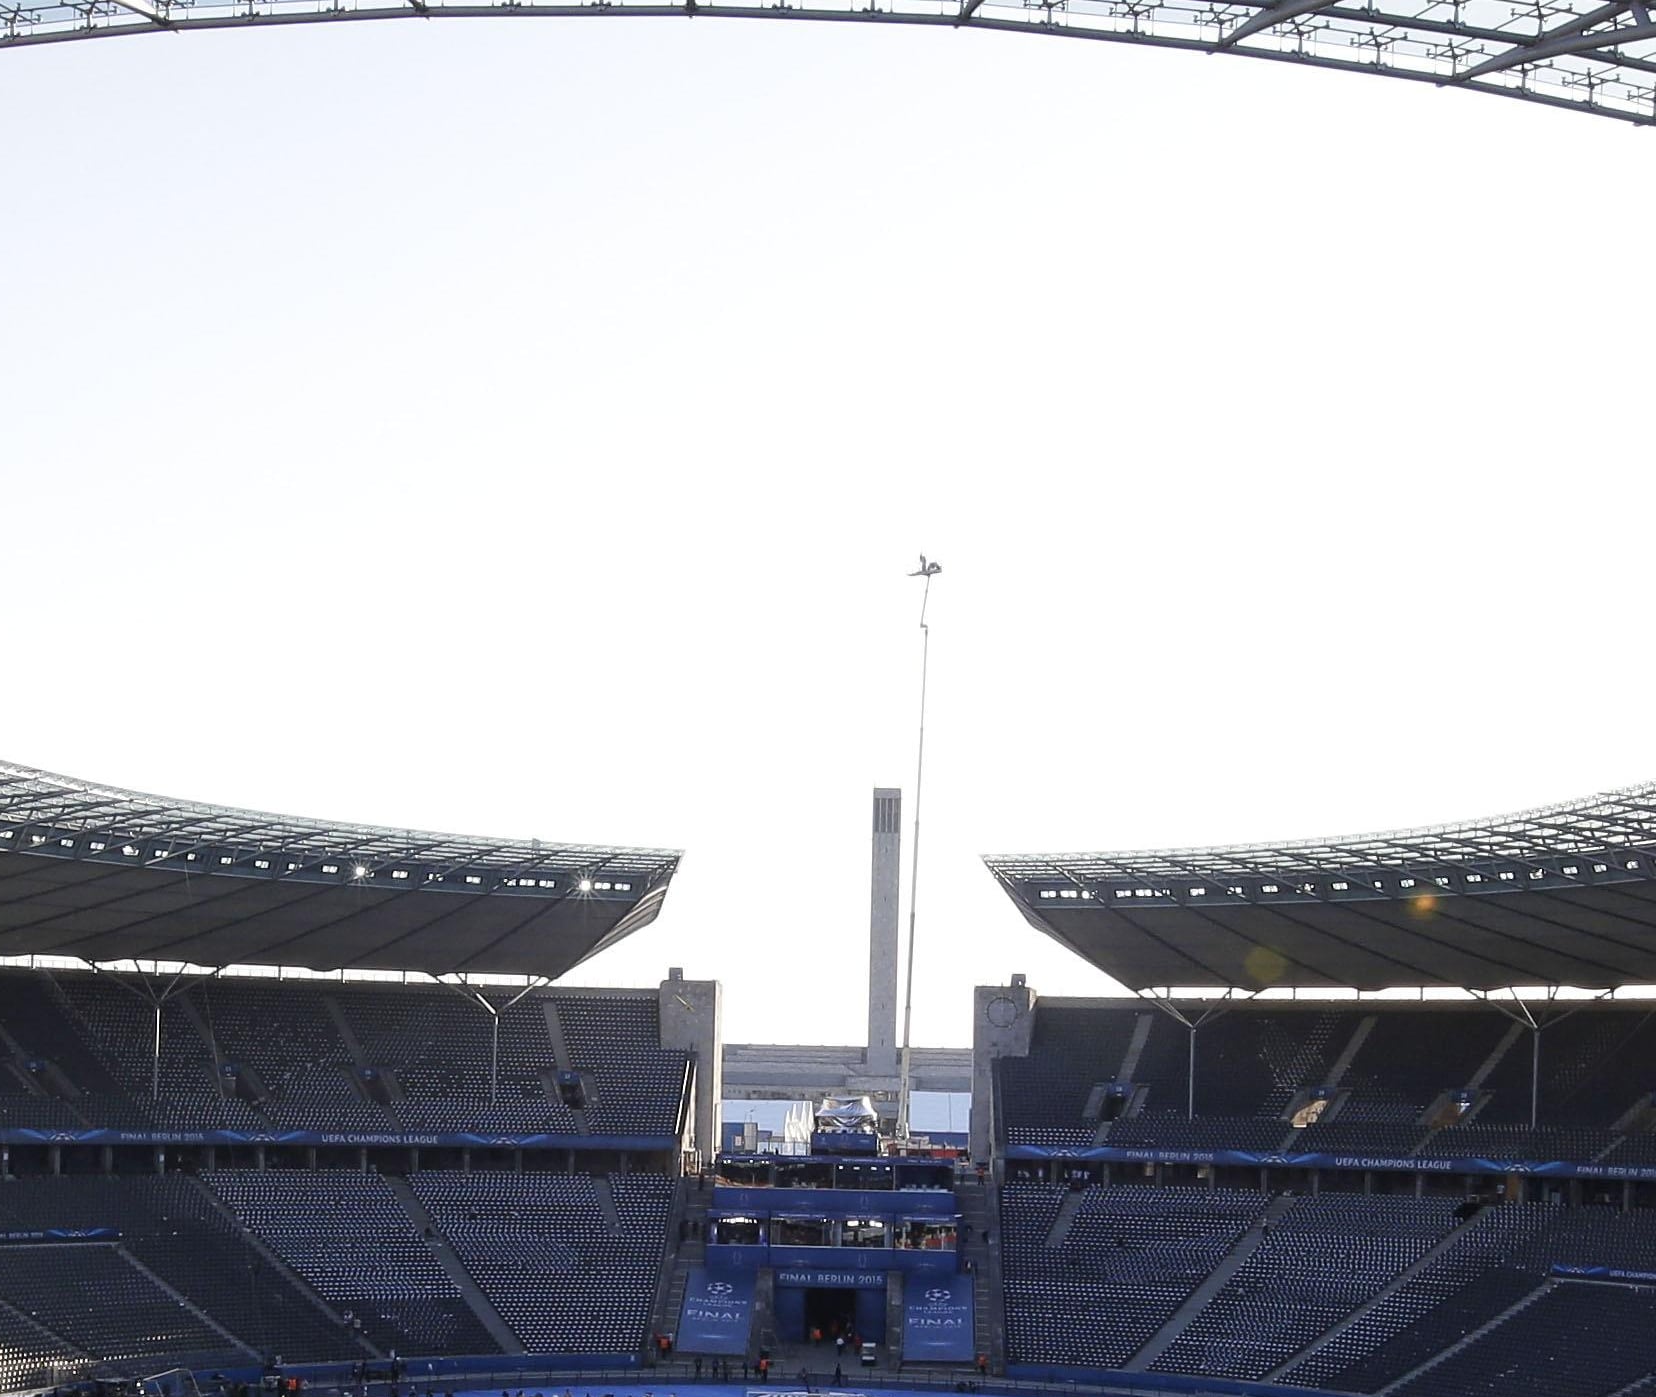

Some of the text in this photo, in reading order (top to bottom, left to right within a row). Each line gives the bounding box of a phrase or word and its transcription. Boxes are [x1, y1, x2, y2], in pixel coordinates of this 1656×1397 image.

[321, 1134, 439, 1144] UEFA CHAMPIONS LEAGUE
[1335, 1158, 1452, 1169] UEFA CHAMPIONS LEAGUE
[779, 1273, 884, 1285] FINAL BERLIN 2015
